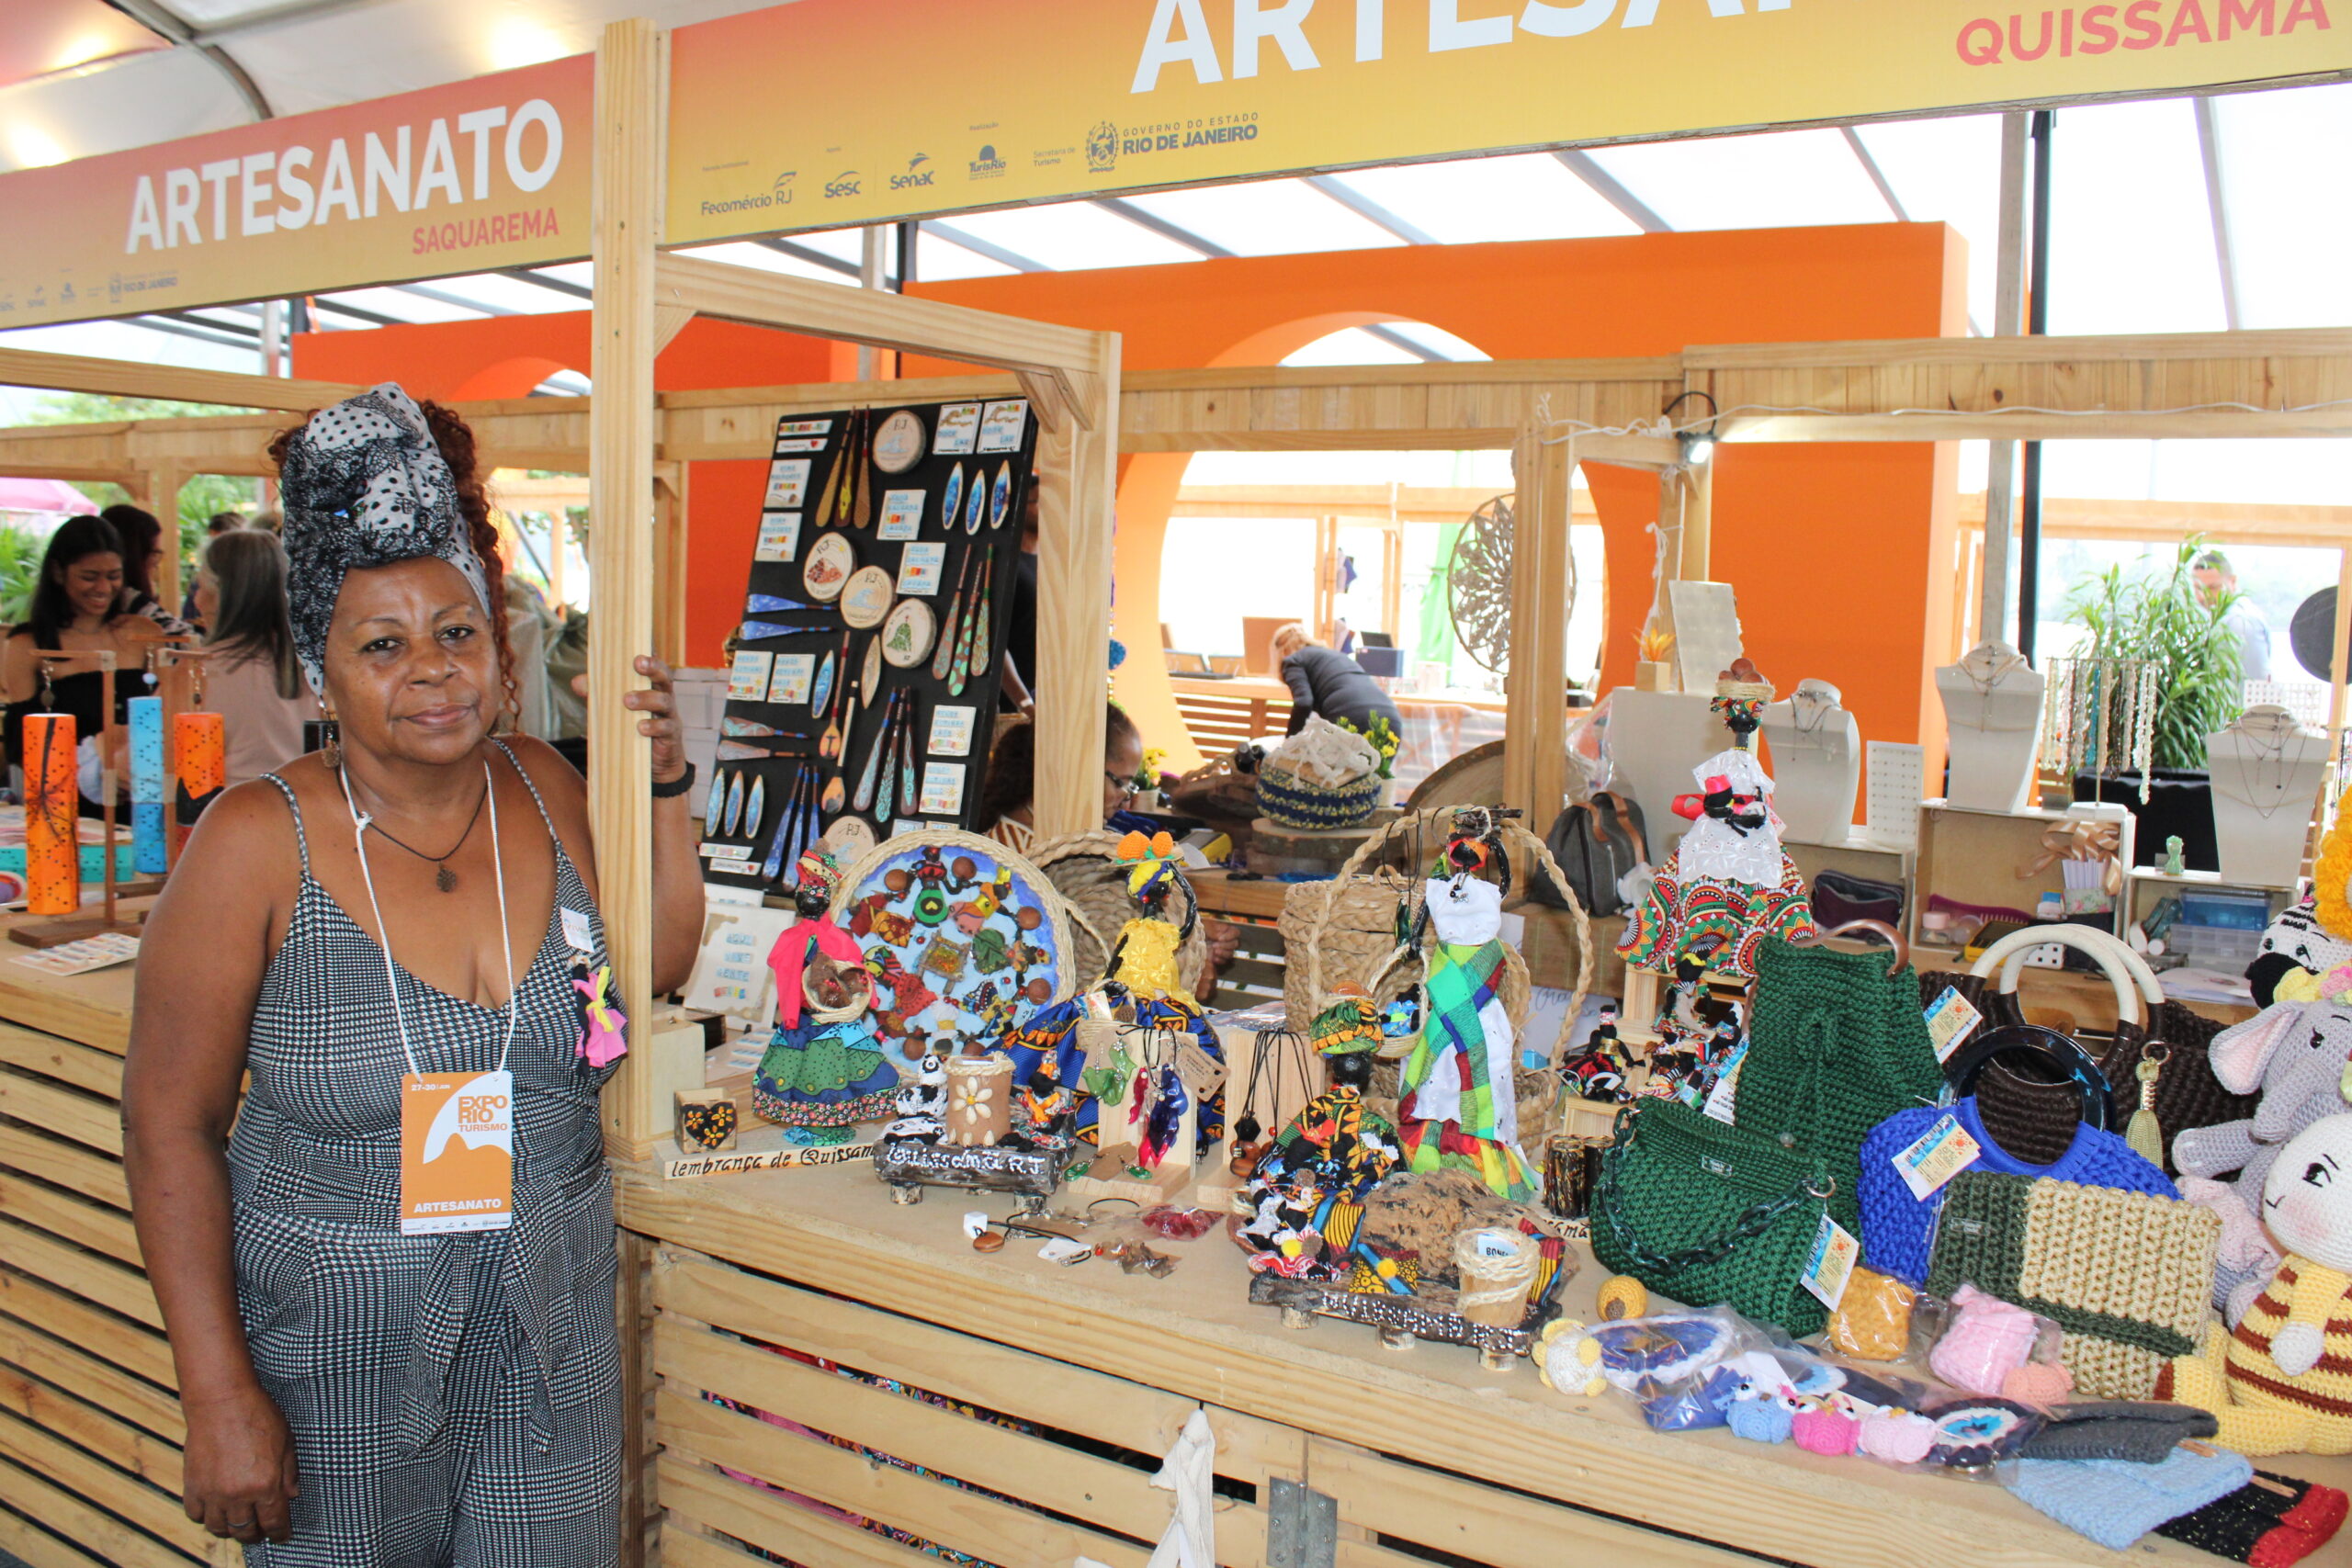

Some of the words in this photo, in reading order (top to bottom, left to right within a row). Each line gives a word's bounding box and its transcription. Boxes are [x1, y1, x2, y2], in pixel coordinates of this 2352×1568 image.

[1123, 121, 1181, 137] GOVERNO
[1187, 118, 1204, 129] DO
[1210, 112, 1259, 126] ESTADO
[1123, 138, 1152, 155] RIO
[1156, 134, 1179, 151] DE
[1182, 124, 1258, 148] JANEIRO
[126, 98, 563, 254] ARTESANATO
[890, 171, 934, 190] Senac
[824, 180, 861, 198] Sesc
[701, 192, 772, 216] Fecomércio
[775, 189, 793, 205] RJ
[412, 207, 560, 255] SAQUAREMA
[458, 1095, 508, 1109] EXPO
[458, 1109, 493, 1123] RIO
[458, 1122, 508, 1133] TURISMO
[672, 1156, 763, 1177] lembrança
[770, 1151, 792, 1168] de
[414, 1199, 502, 1213] ARTESANATO
